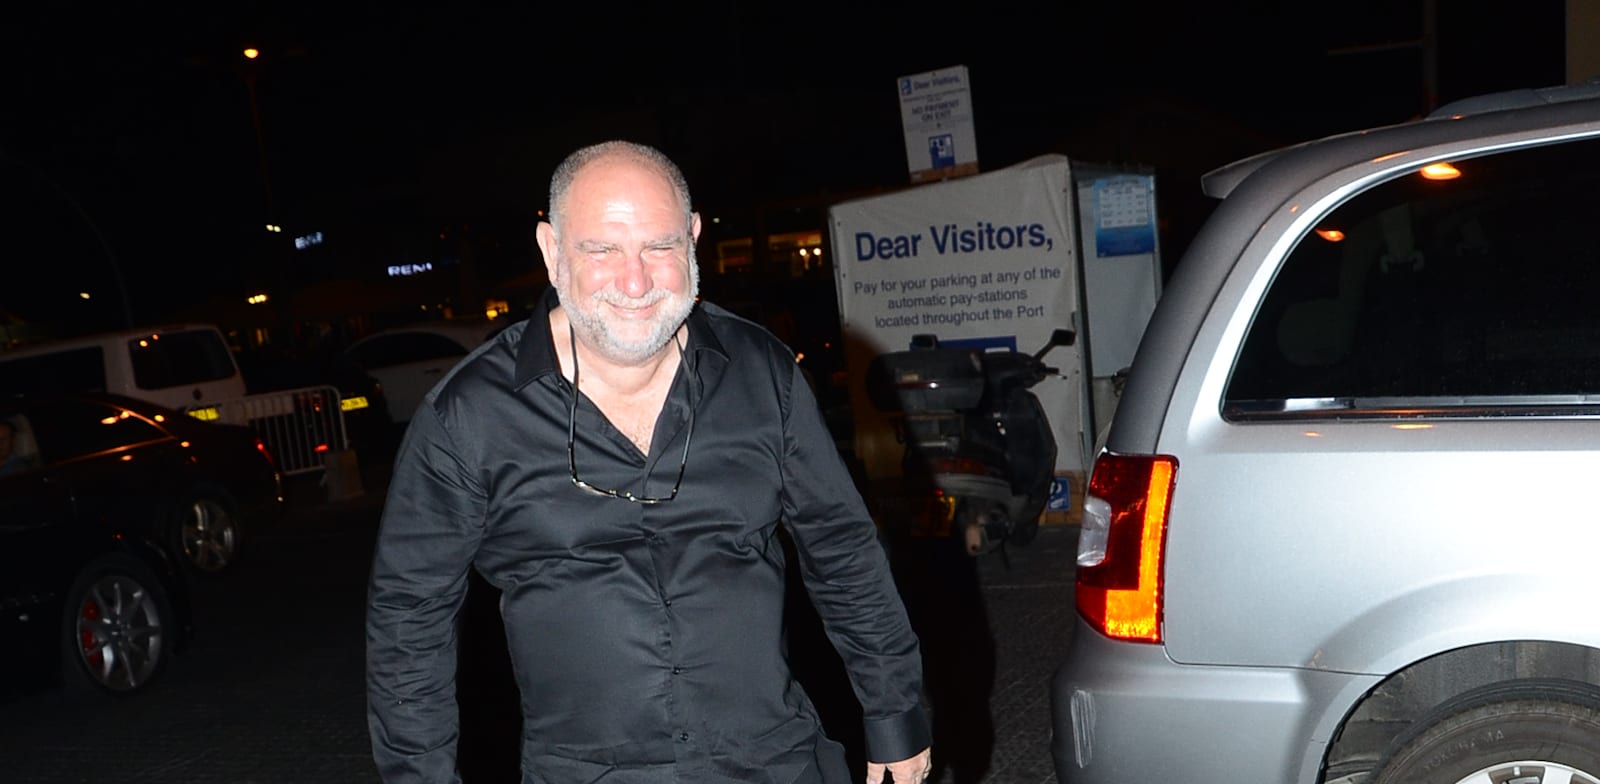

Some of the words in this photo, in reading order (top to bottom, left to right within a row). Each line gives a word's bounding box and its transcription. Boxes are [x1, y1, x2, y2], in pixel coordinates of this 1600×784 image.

[855, 232, 921, 262] Dear
[930, 221, 1053, 255] Visitors,
[854, 281, 877, 296] Pay
[881, 278, 897, 292] for
[900, 279, 926, 294] your
[931, 272, 977, 291] parking
[981, 272, 993, 284] at
[996, 271, 1020, 286] any
[1023, 267, 1038, 281] of
[1039, 266, 1061, 280] the
[887, 295, 947, 310] automatic
[950, 288, 1028, 306] pay-stations
[875, 313, 919, 329] located
[922, 309, 989, 327] throughout
[992, 307, 1013, 320] the
[1016, 305, 1044, 319] Port
